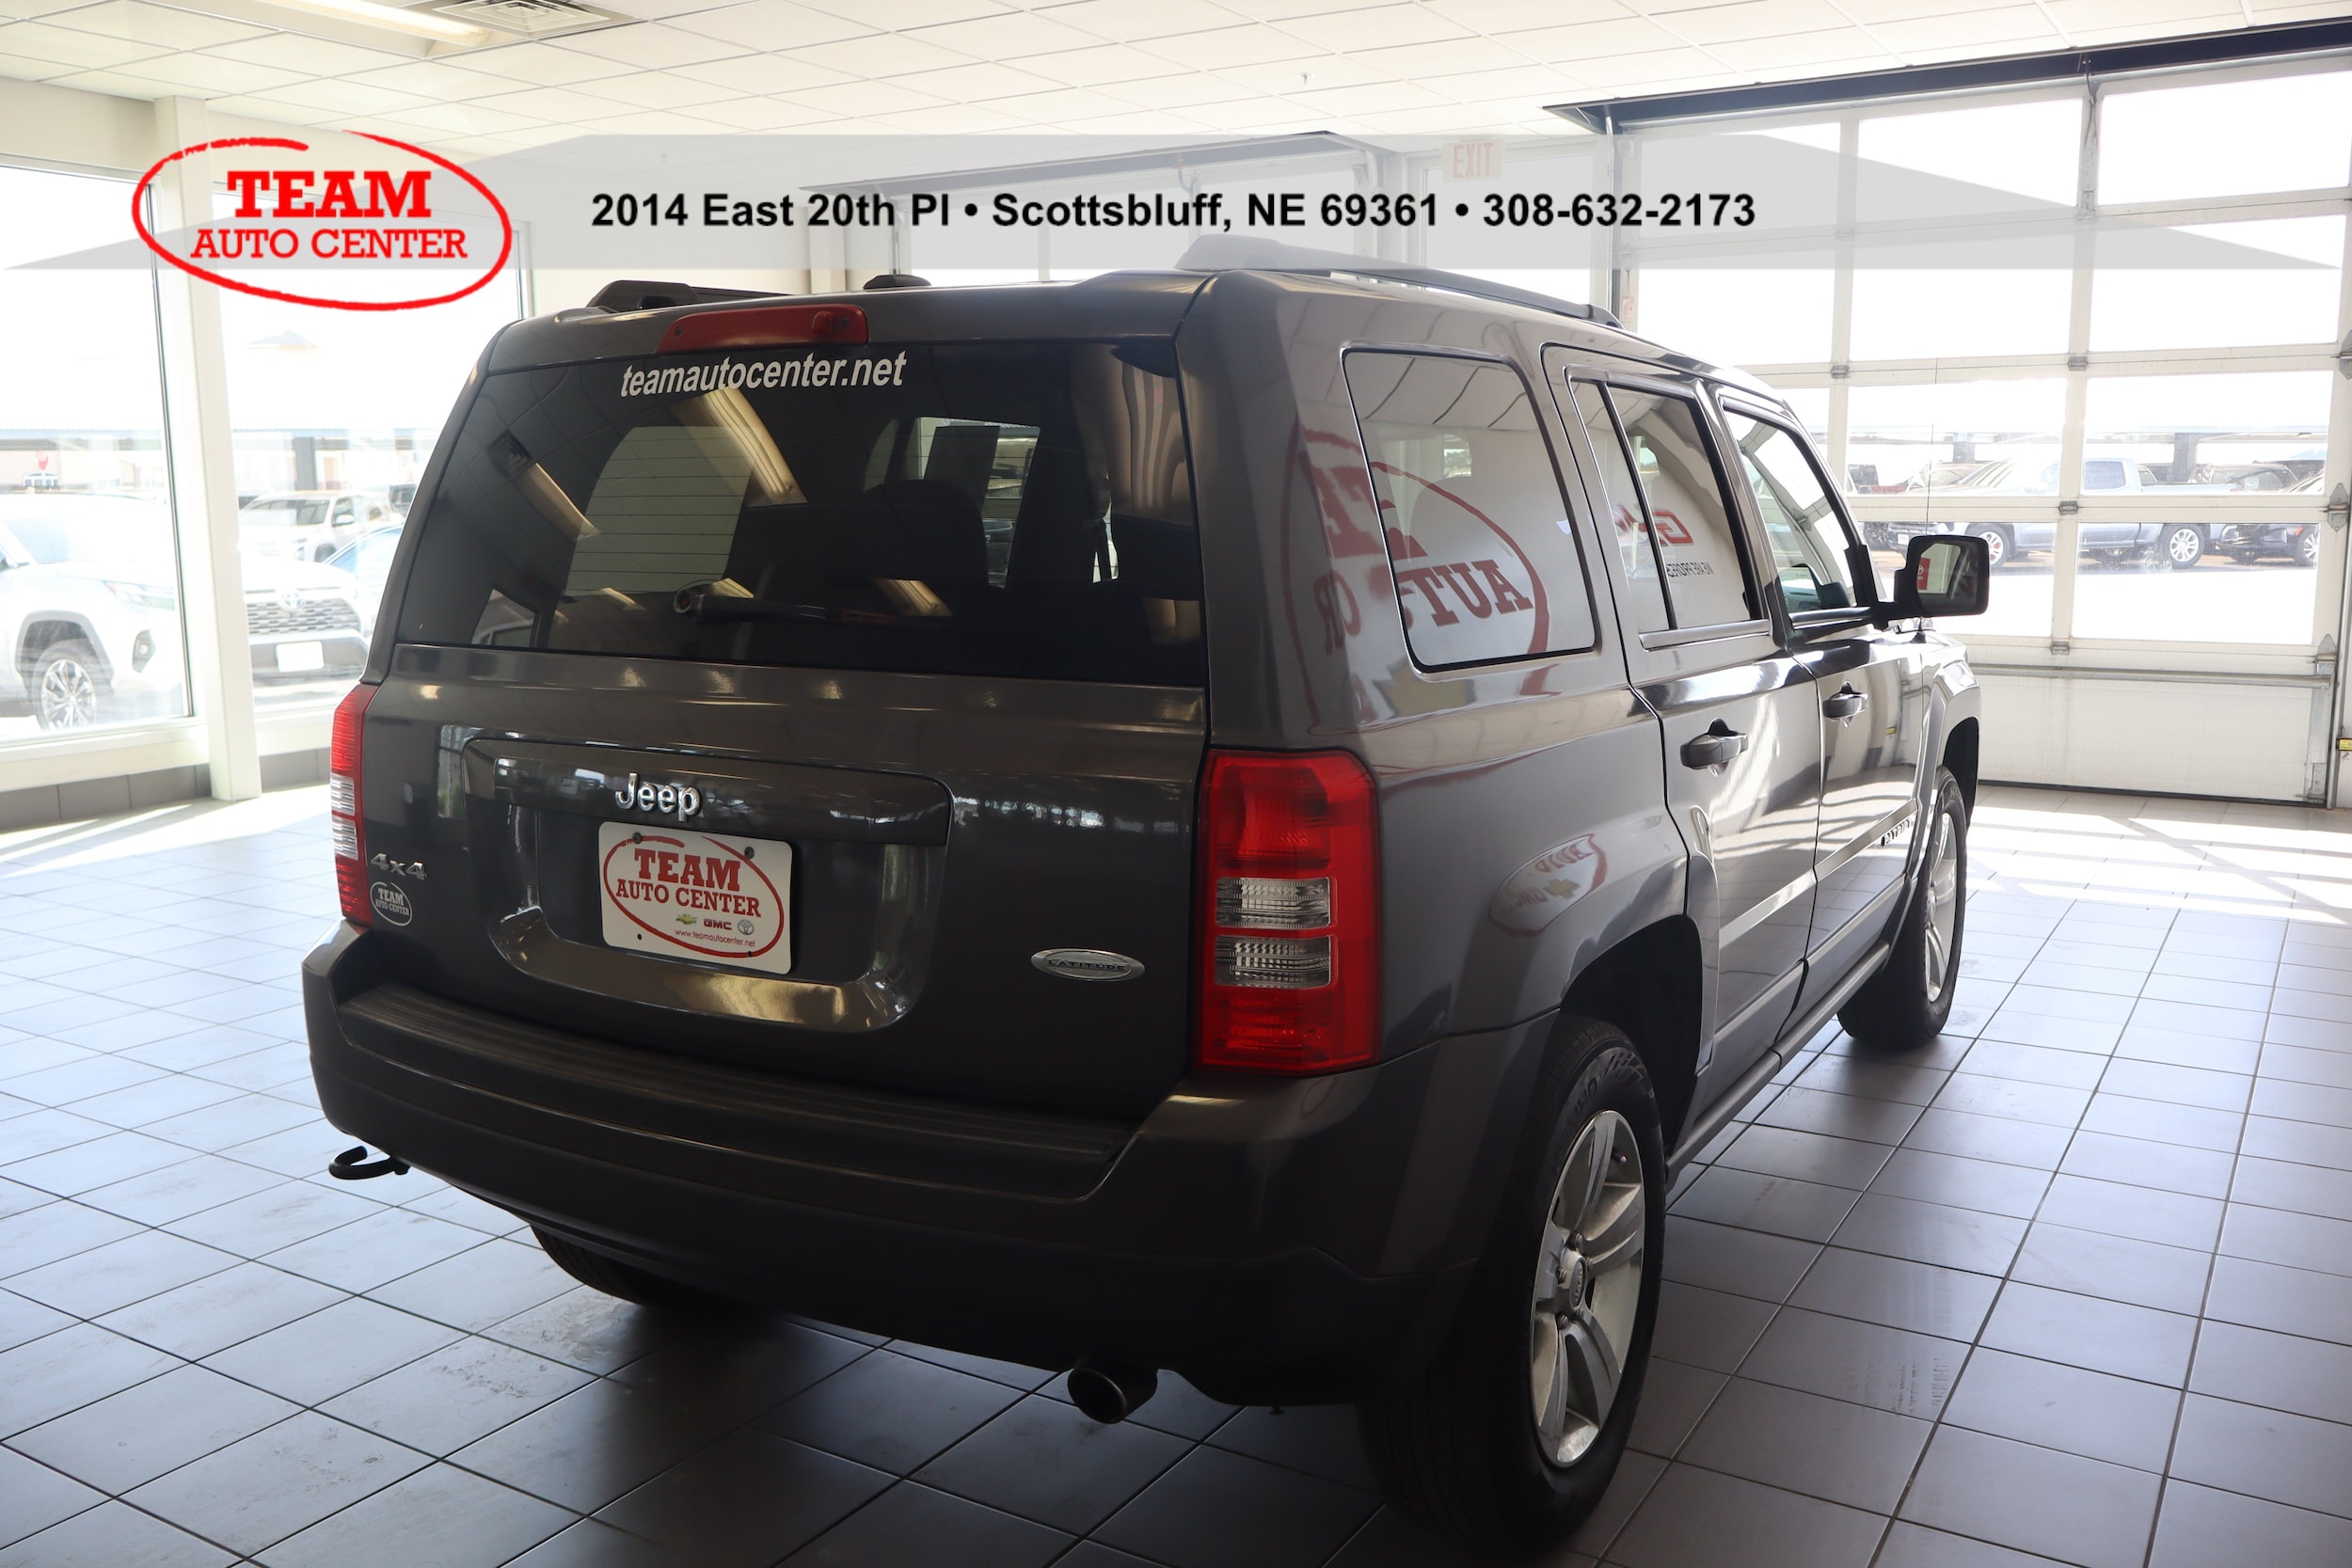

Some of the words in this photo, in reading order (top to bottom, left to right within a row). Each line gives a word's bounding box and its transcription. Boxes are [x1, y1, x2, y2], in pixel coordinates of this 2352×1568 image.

[1453, 142, 1493, 179] EXIT
[621, 351, 909, 398] teamautocenter.net
[614, 772, 701, 822] Jeep
[371, 852, 427, 881] 4x4
[634, 847, 741, 893] TEAM
[377, 887, 405, 907] TEAM
[389, 902, 410, 916] CENTER
[615, 879, 670, 904] AUTO
[675, 887, 762, 918] CENTER
[674, 927, 756, 948] www.teamautocenter.net
[703, 918, 733, 931] GMC
[1047, 958, 1125, 971] LATITUDE
